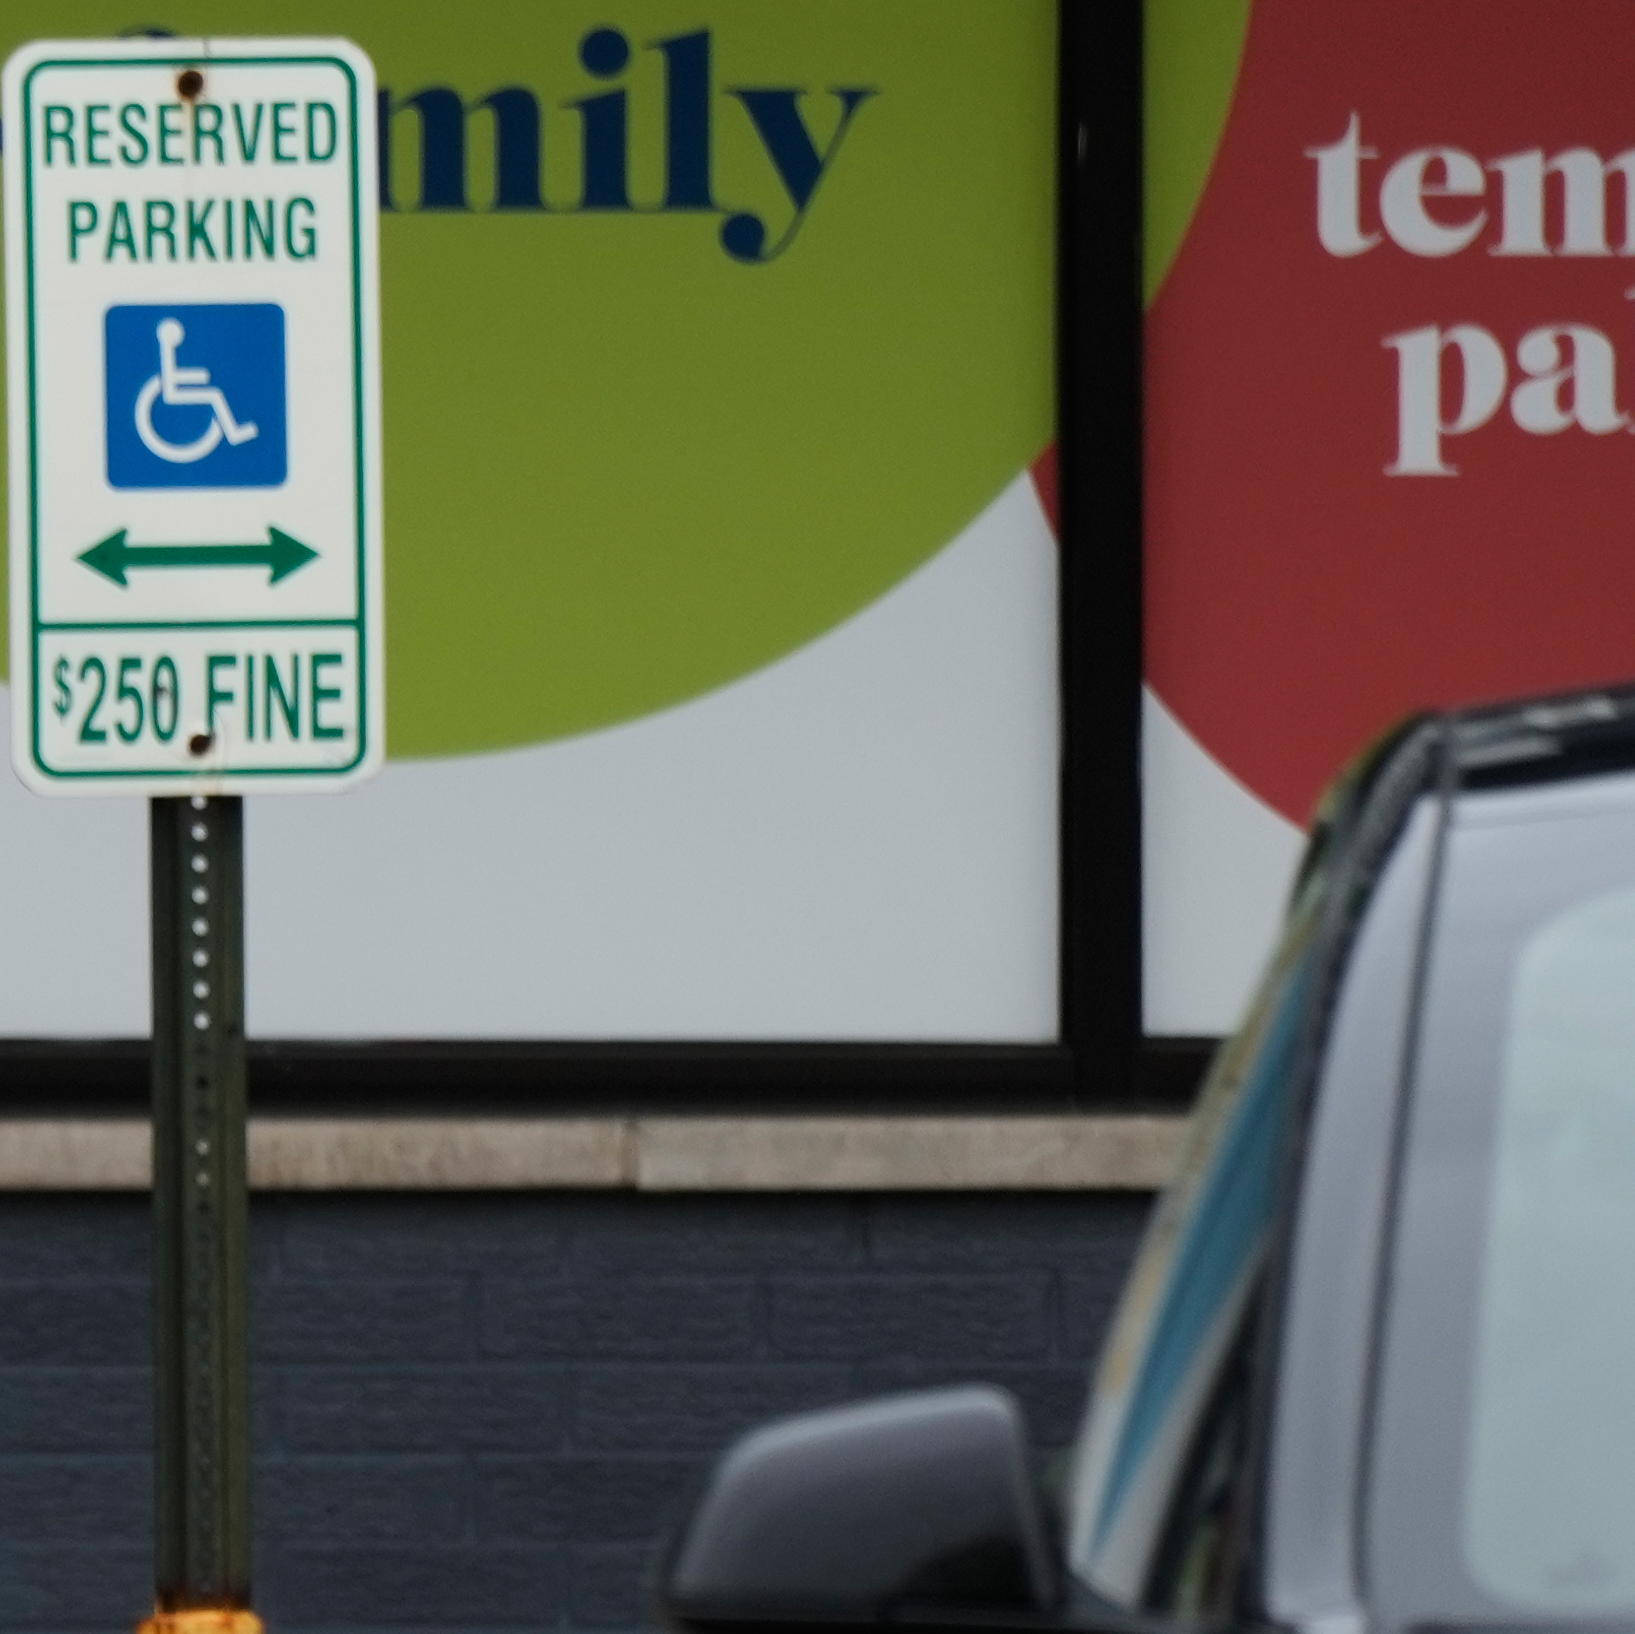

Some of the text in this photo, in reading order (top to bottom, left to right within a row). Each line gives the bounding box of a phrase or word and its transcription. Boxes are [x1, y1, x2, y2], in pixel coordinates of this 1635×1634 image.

[42, 101, 338, 168] RESERVED
[116, 26, 881, 266] mily
[67, 197, 318, 263] PARKING
[1380, 288, 1635, 478] pa
[52, 652, 346, 745] $250 FINE
